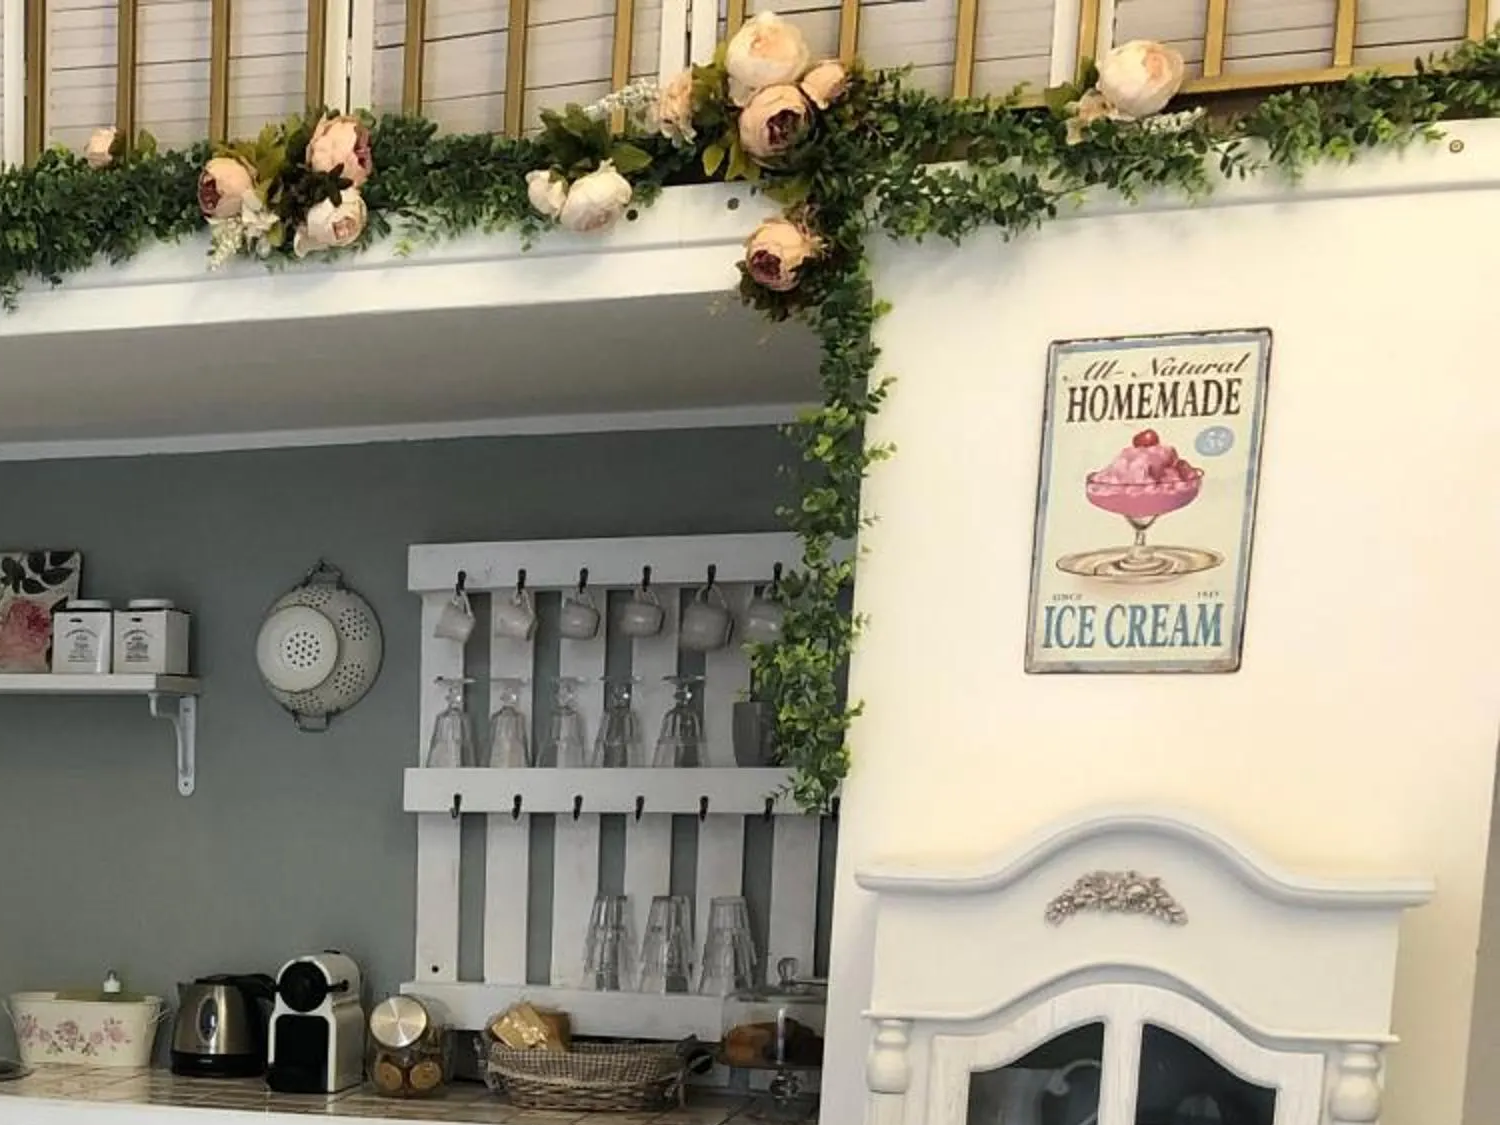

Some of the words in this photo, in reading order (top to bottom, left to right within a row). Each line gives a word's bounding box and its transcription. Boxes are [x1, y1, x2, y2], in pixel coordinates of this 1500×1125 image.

[1131, 352, 1251, 378] Natural
[1066, 377, 1242, 423] HOMEMADE
[1043, 604, 1097, 649] ICE
[1104, 603, 1224, 649] CREAM
